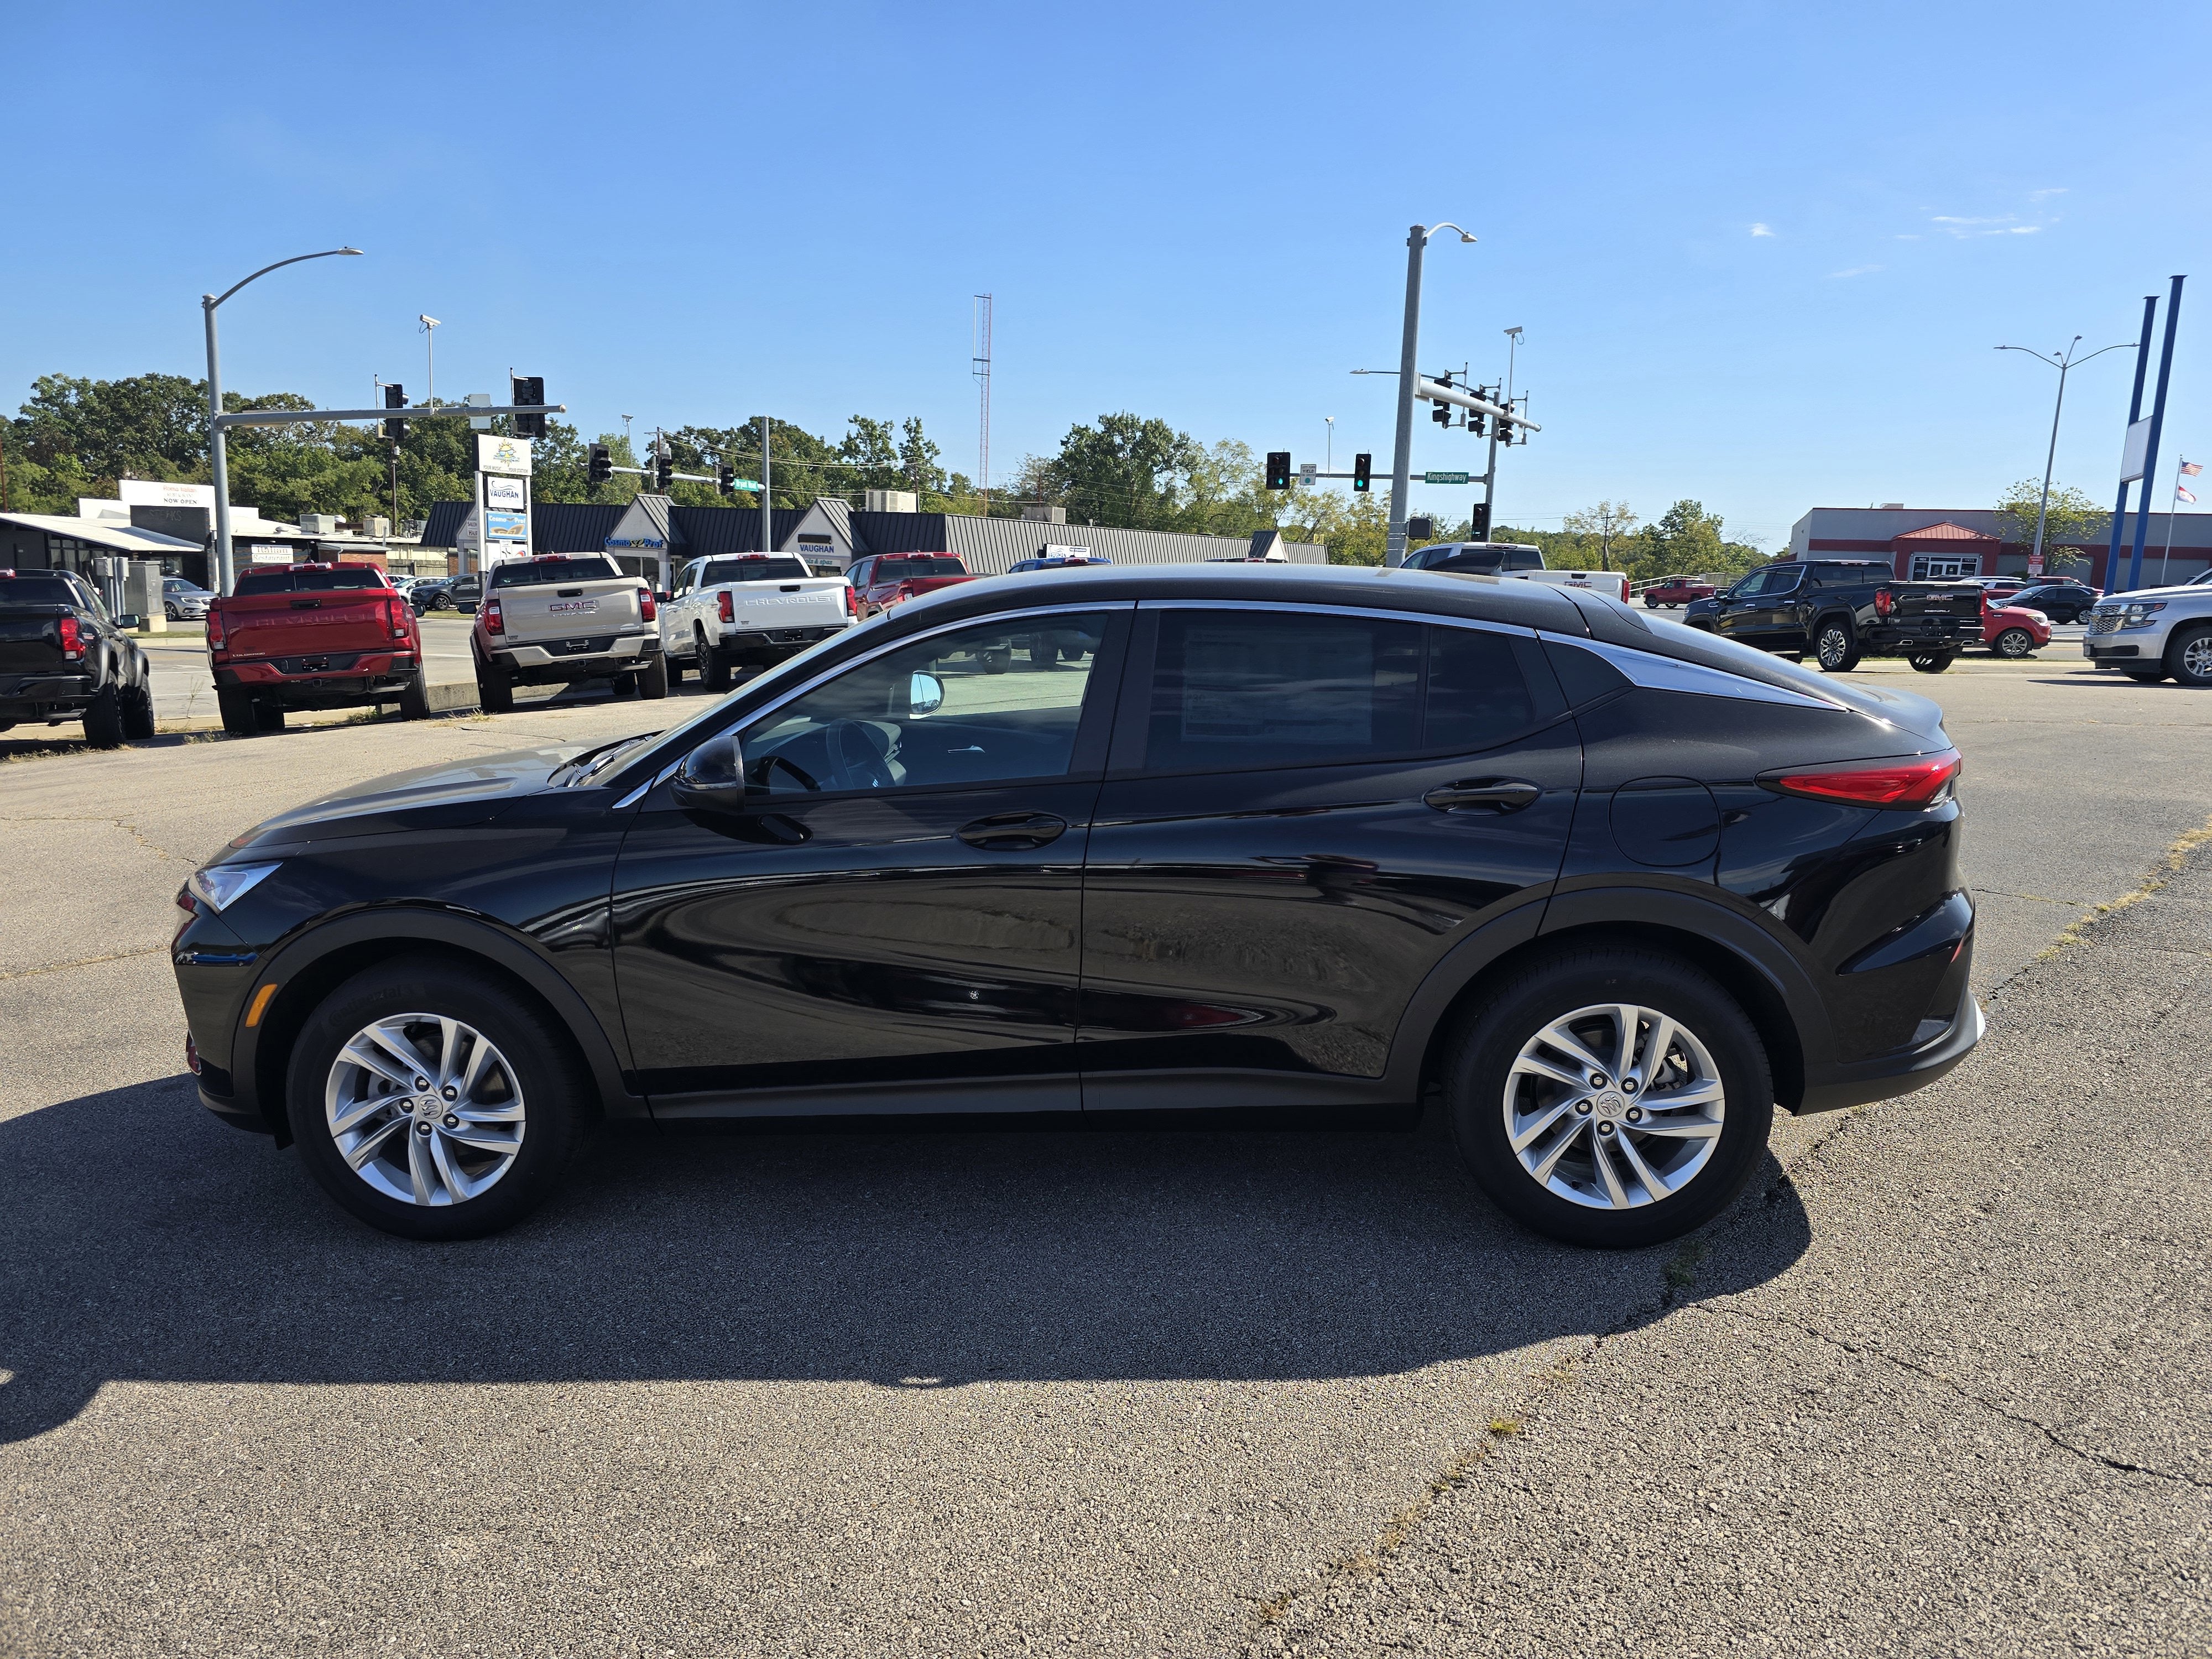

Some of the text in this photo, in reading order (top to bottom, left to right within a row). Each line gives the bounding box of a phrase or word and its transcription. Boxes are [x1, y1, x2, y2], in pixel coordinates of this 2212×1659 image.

[1427, 472, 1467, 483] Kingshighway
[490, 489, 519, 498] VAUGHAN
[604, 536, 664, 548] Cosmo Prof
[800, 544, 834, 553] VAUGHAN
[549, 600, 597, 612] GMC
[745, 596, 836, 606] CHEVROLET
